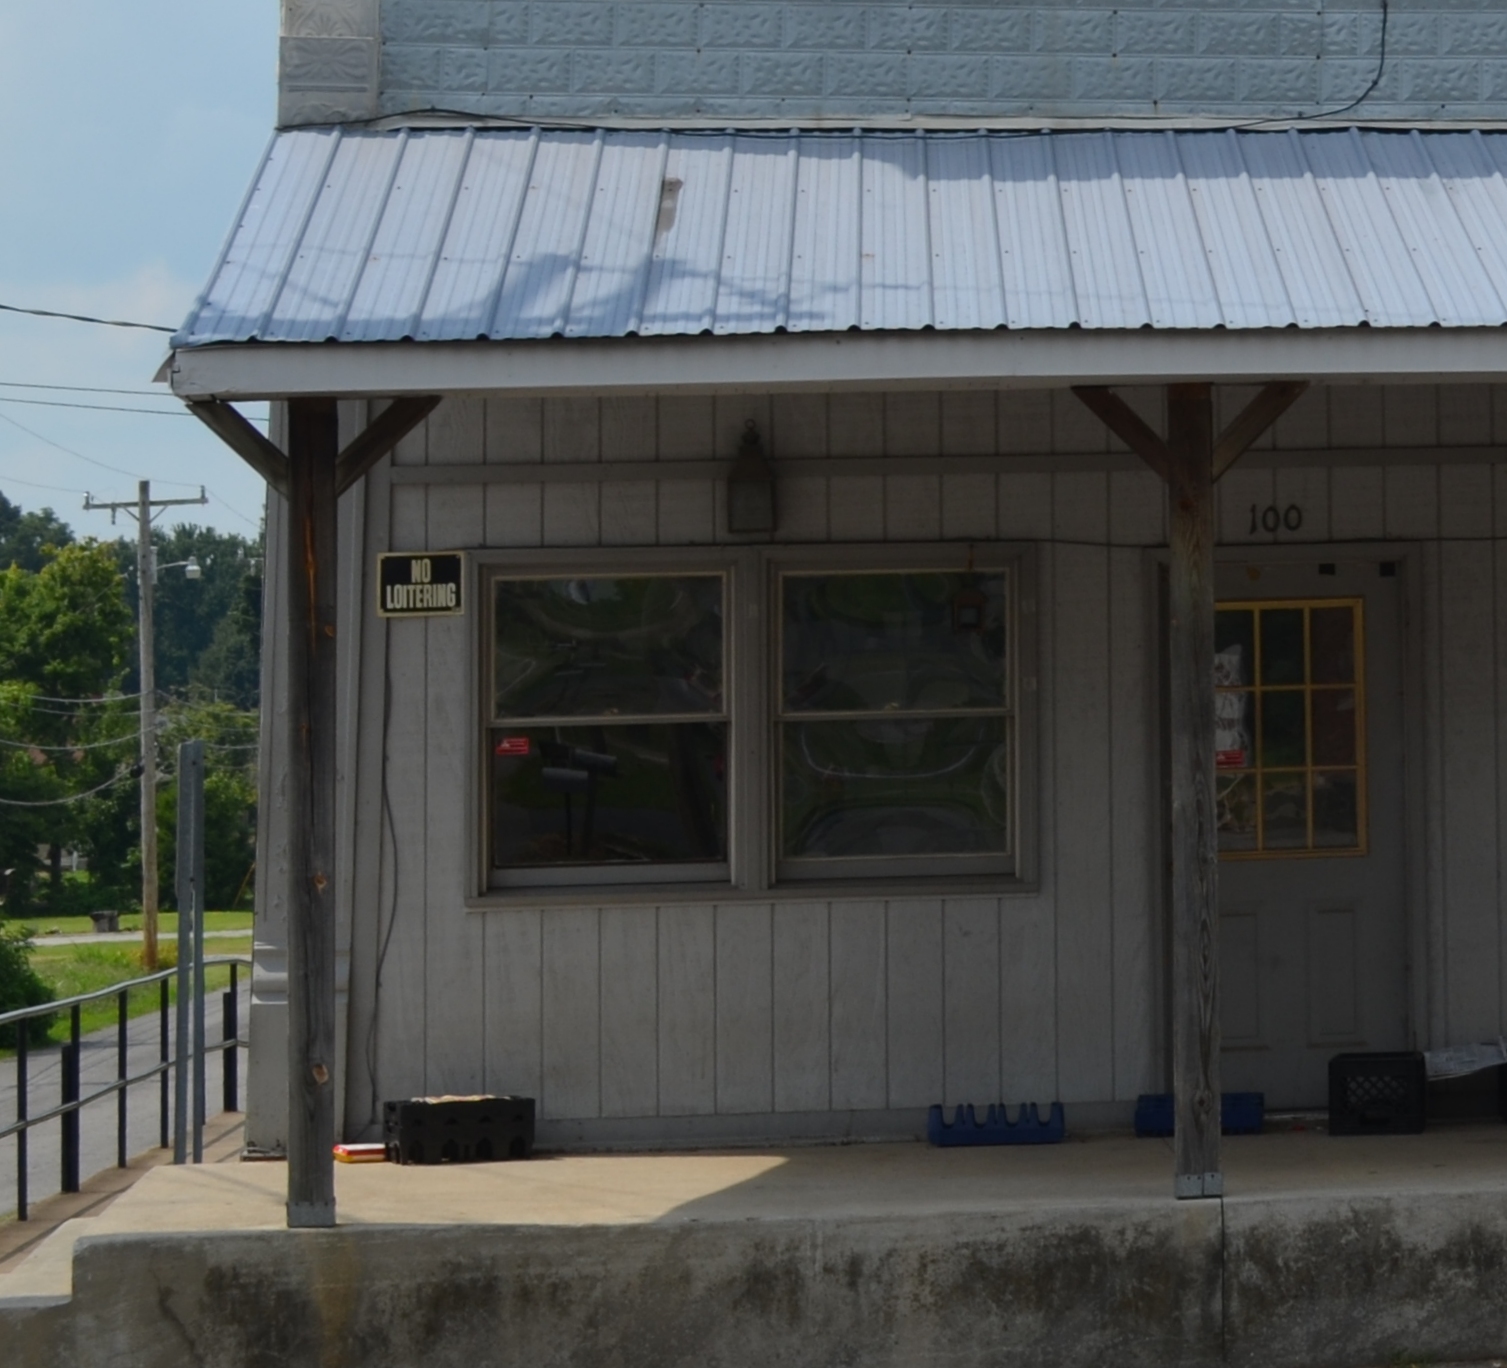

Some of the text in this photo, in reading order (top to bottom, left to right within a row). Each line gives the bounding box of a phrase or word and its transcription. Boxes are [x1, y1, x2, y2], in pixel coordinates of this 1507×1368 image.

[1249, 503, 1302, 536] 100
[411, 558, 432, 584] NO
[386, 582, 457, 610] LOITERING
